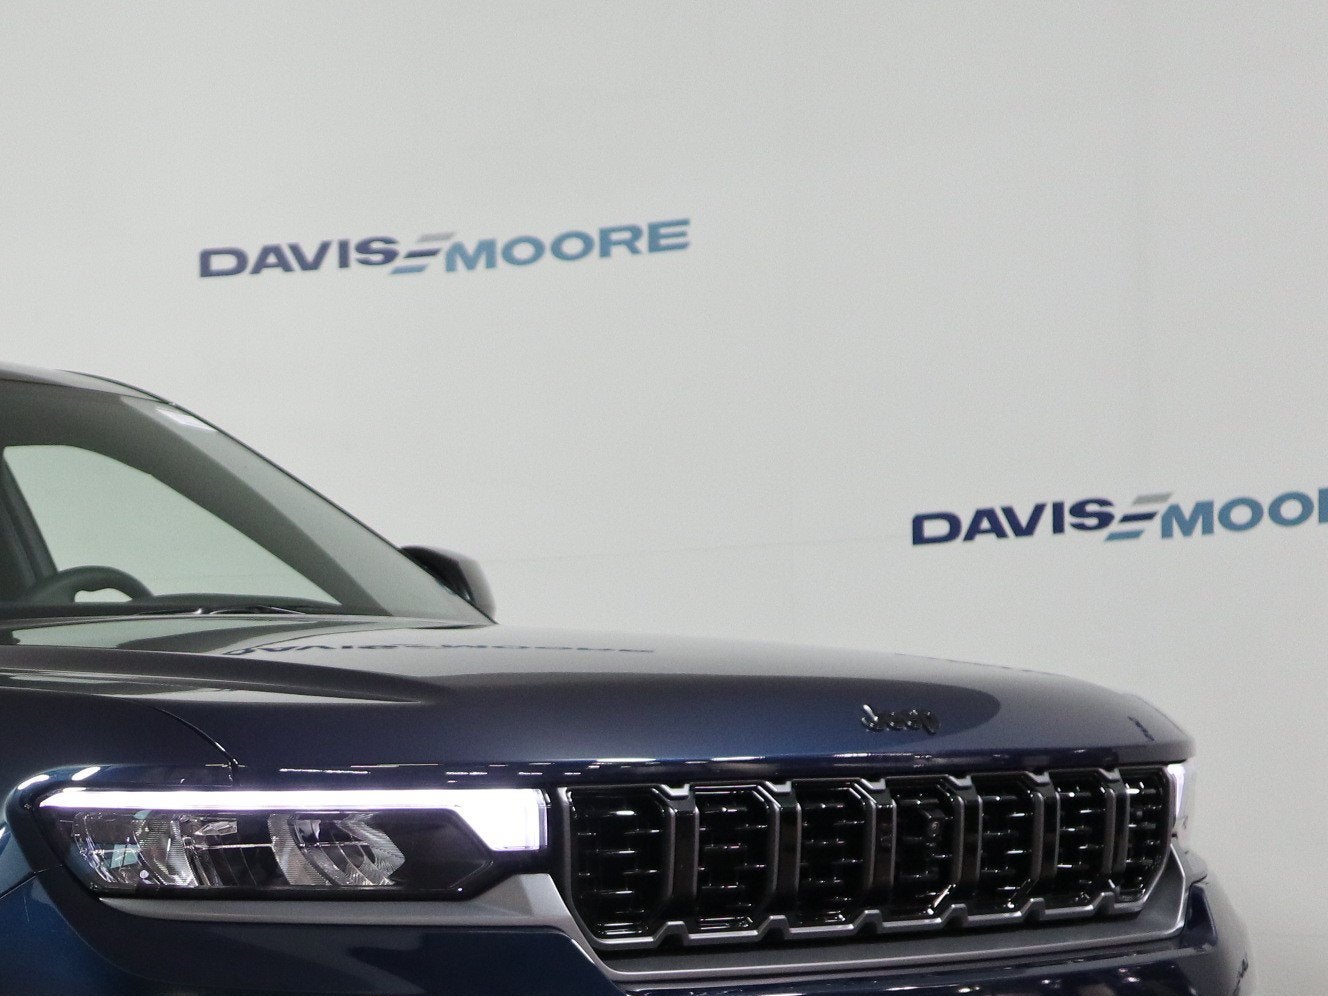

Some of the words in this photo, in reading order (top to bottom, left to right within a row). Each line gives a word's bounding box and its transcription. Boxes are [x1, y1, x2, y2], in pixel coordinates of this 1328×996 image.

[198, 235, 400, 278] DAVIS
[444, 217, 691, 273] MOORE
[912, 498, 1115, 546] DAVIS
